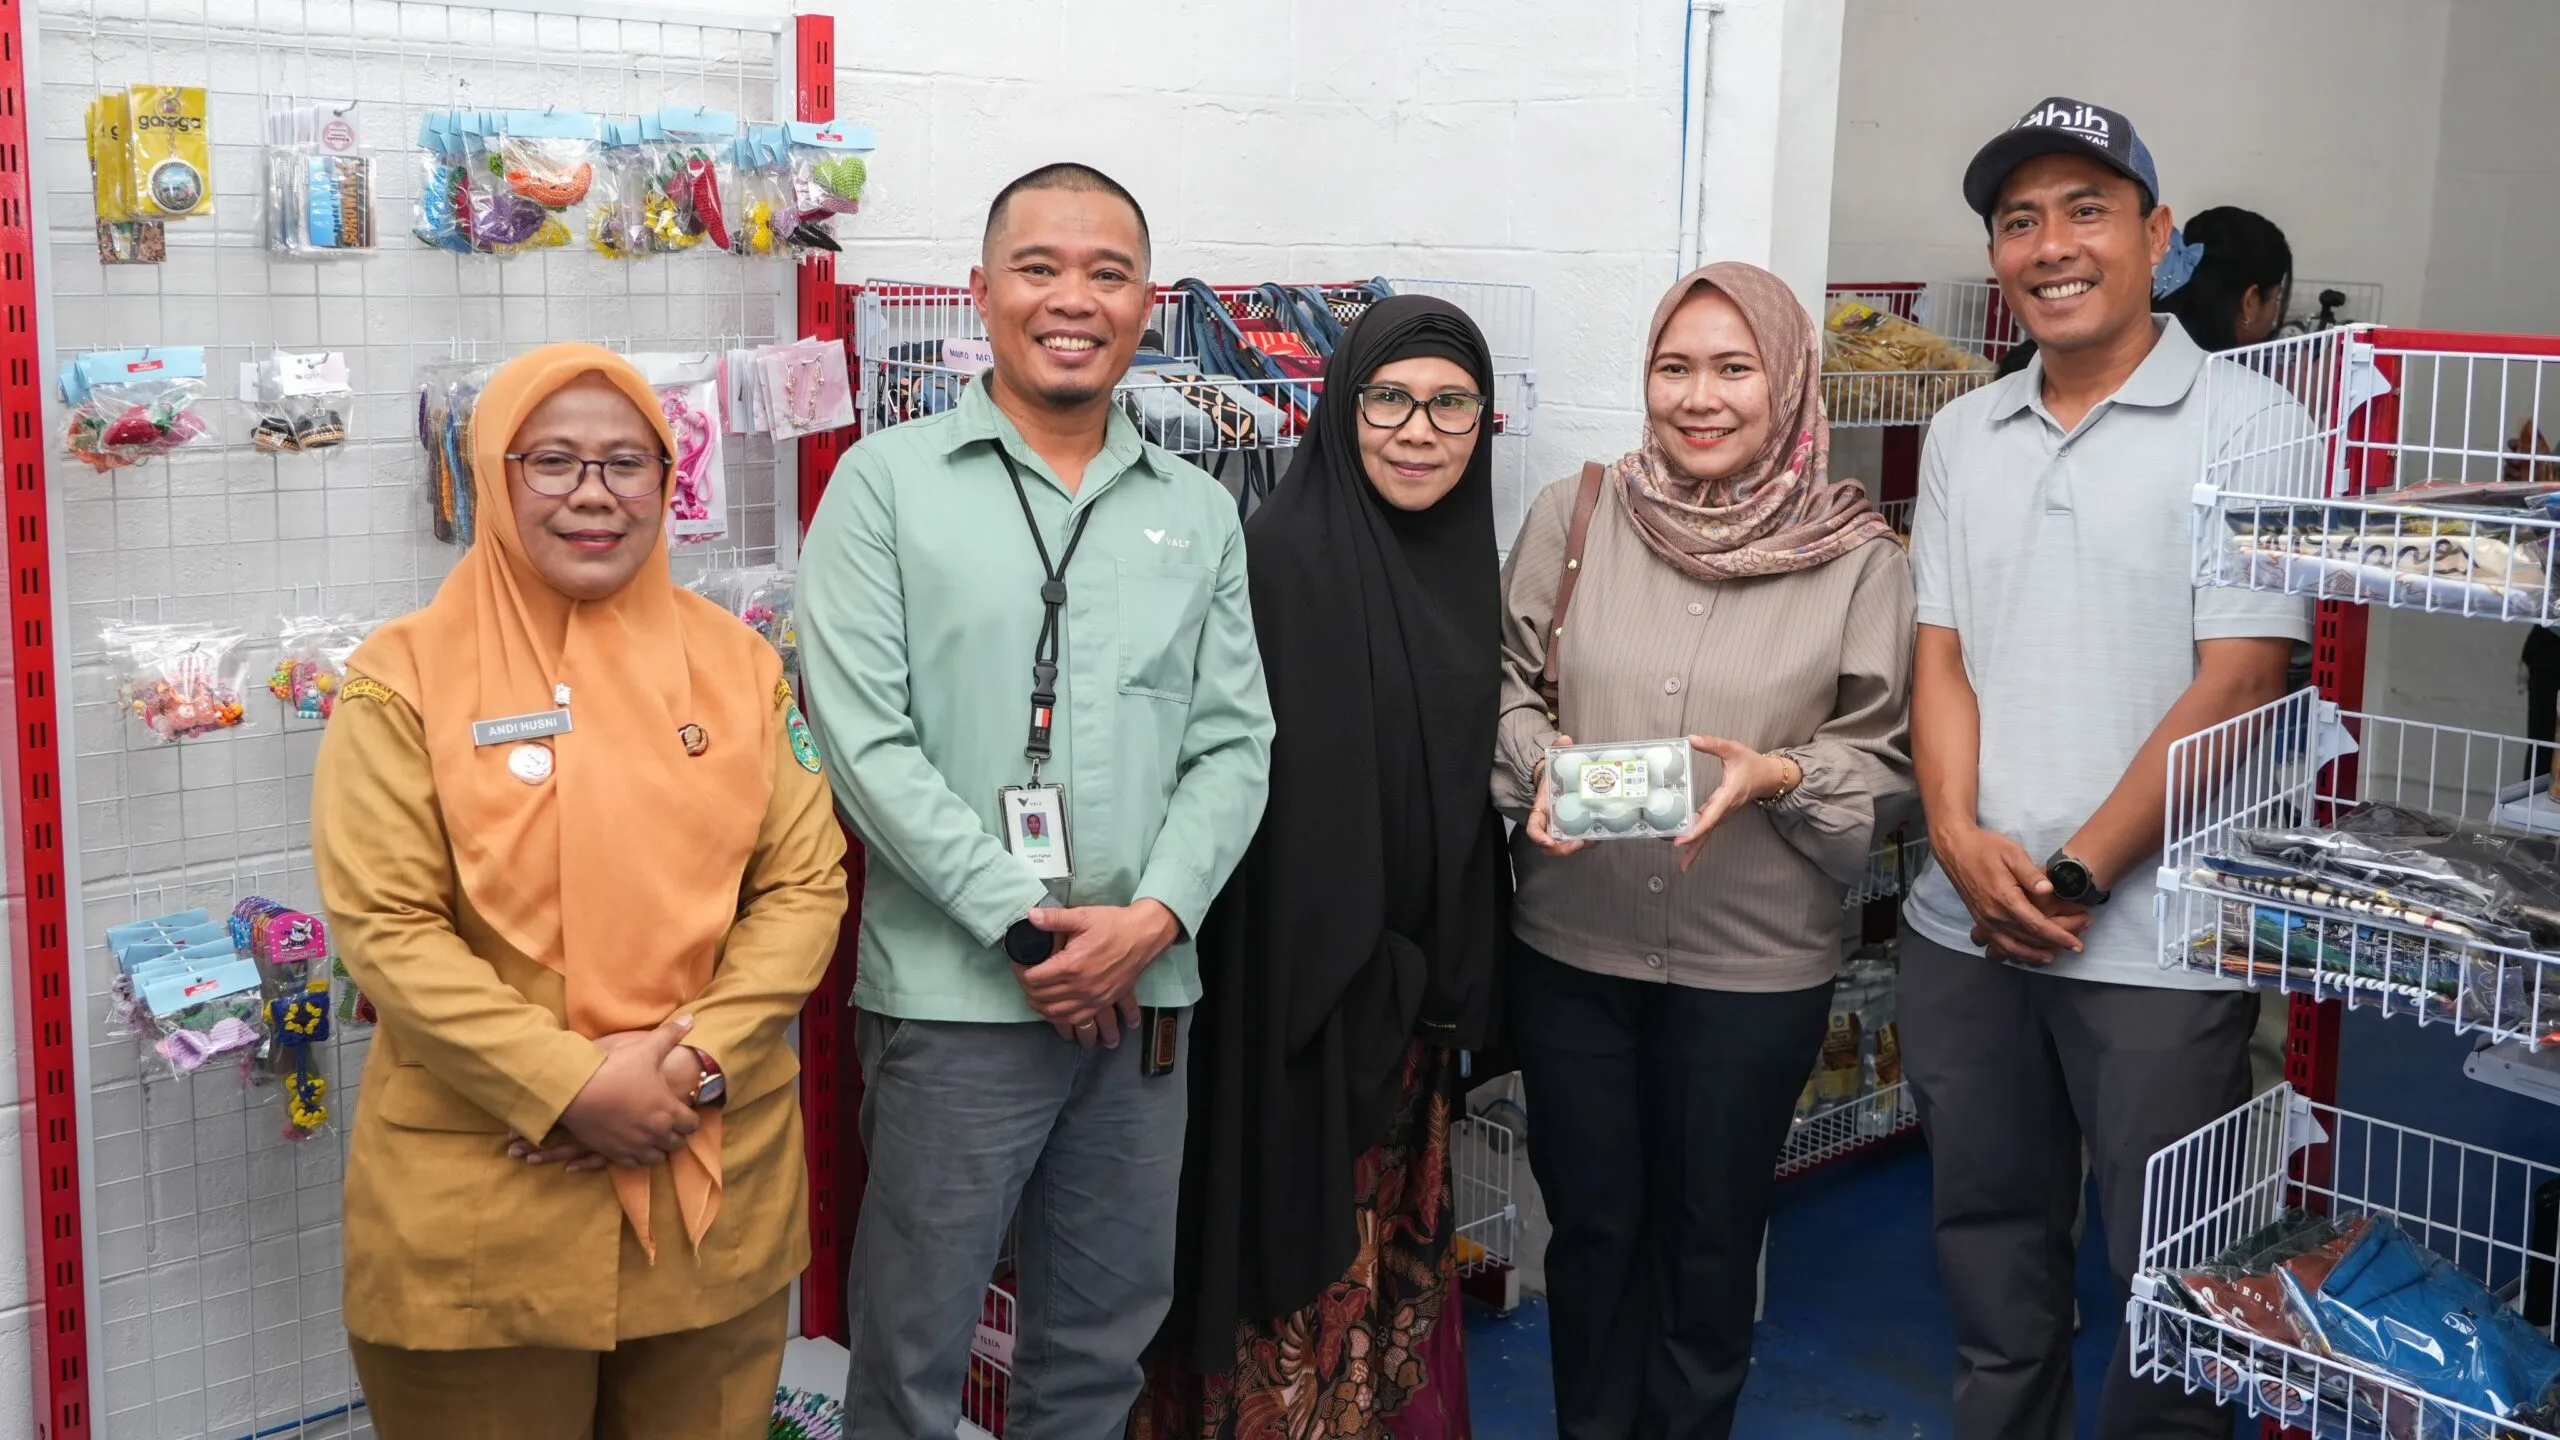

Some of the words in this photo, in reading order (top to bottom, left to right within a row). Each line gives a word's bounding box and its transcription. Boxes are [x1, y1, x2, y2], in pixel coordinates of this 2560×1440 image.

[2079, 134, 2109, 148] YAH
[343, 164, 358, 245] SOROWAK
[489, 723, 518, 737] ANDI
[521, 717, 558, 732] HUSNI
